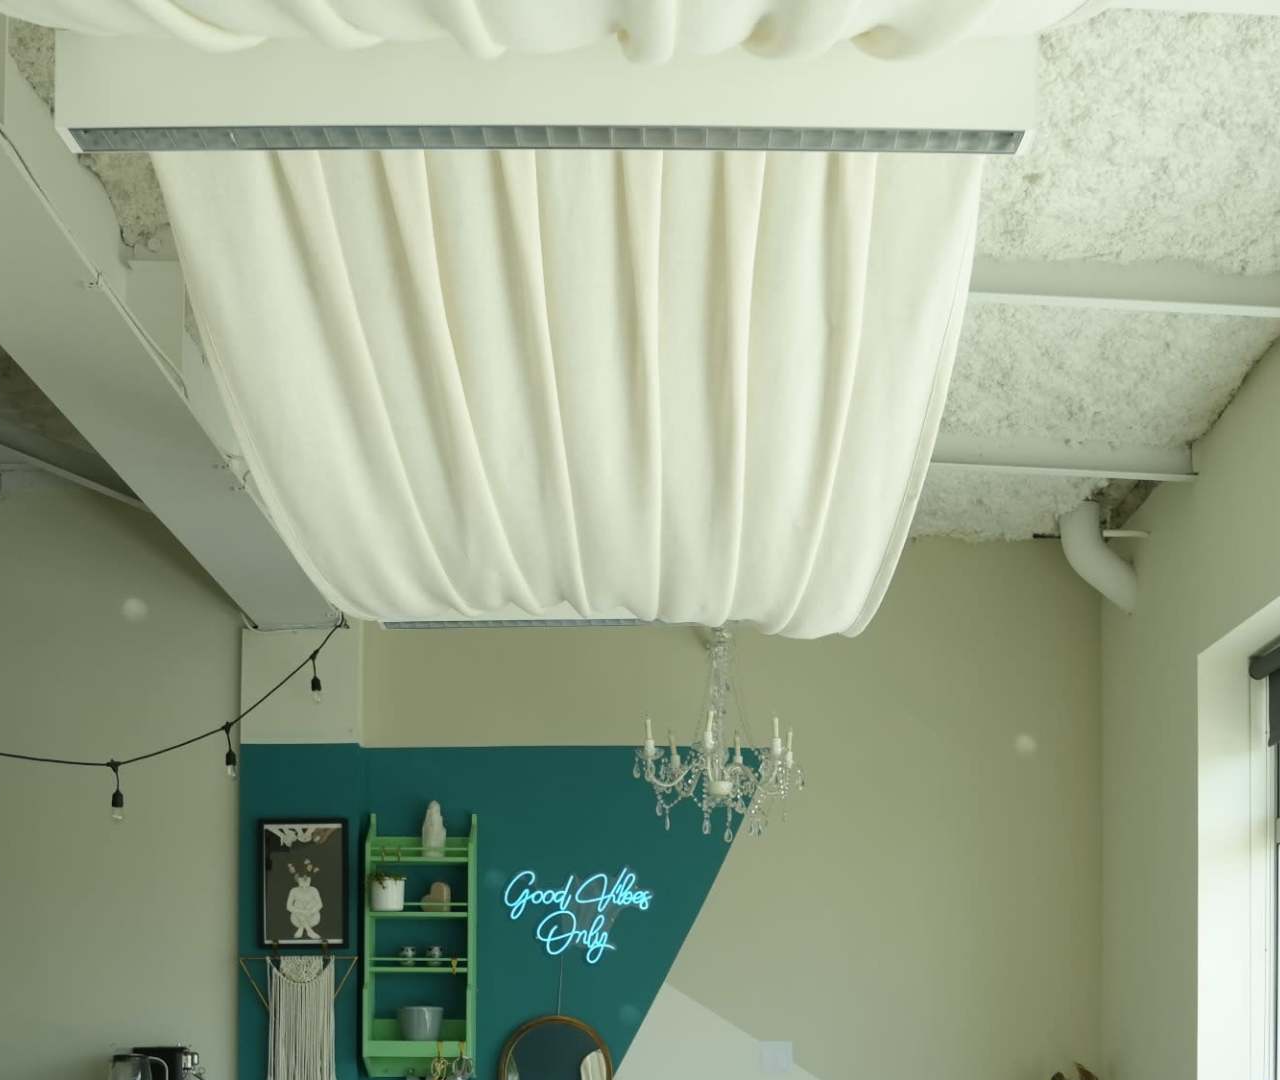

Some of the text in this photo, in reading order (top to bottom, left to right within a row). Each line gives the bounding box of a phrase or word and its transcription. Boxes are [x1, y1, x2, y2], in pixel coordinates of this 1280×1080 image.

[504, 867, 653, 920] Good Vibes
[536, 910, 616, 964] Only
